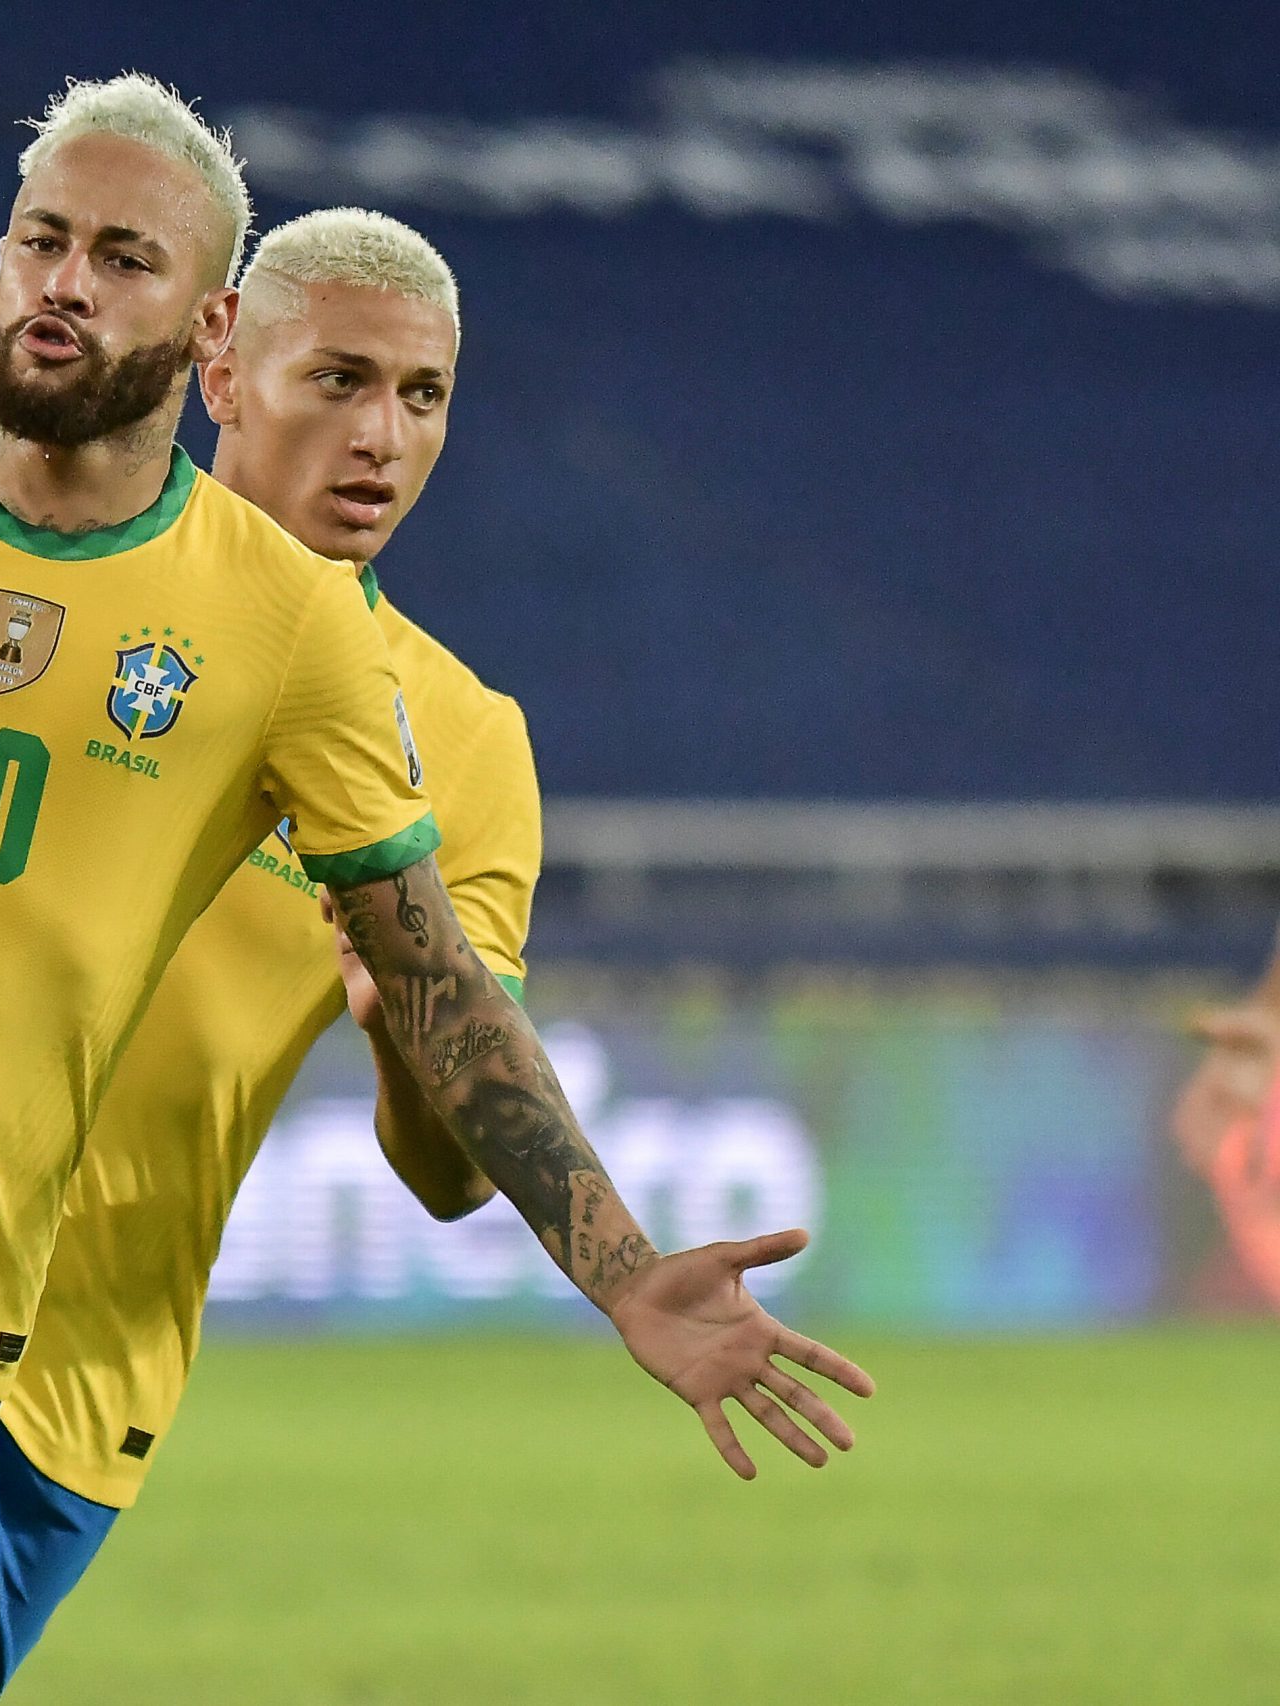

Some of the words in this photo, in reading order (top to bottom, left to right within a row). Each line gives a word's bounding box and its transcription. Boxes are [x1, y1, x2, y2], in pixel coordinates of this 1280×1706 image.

[134, 680, 165, 698] CBF
[84, 738, 161, 780] BRASIL
[248, 848, 318, 899] BRASIL
